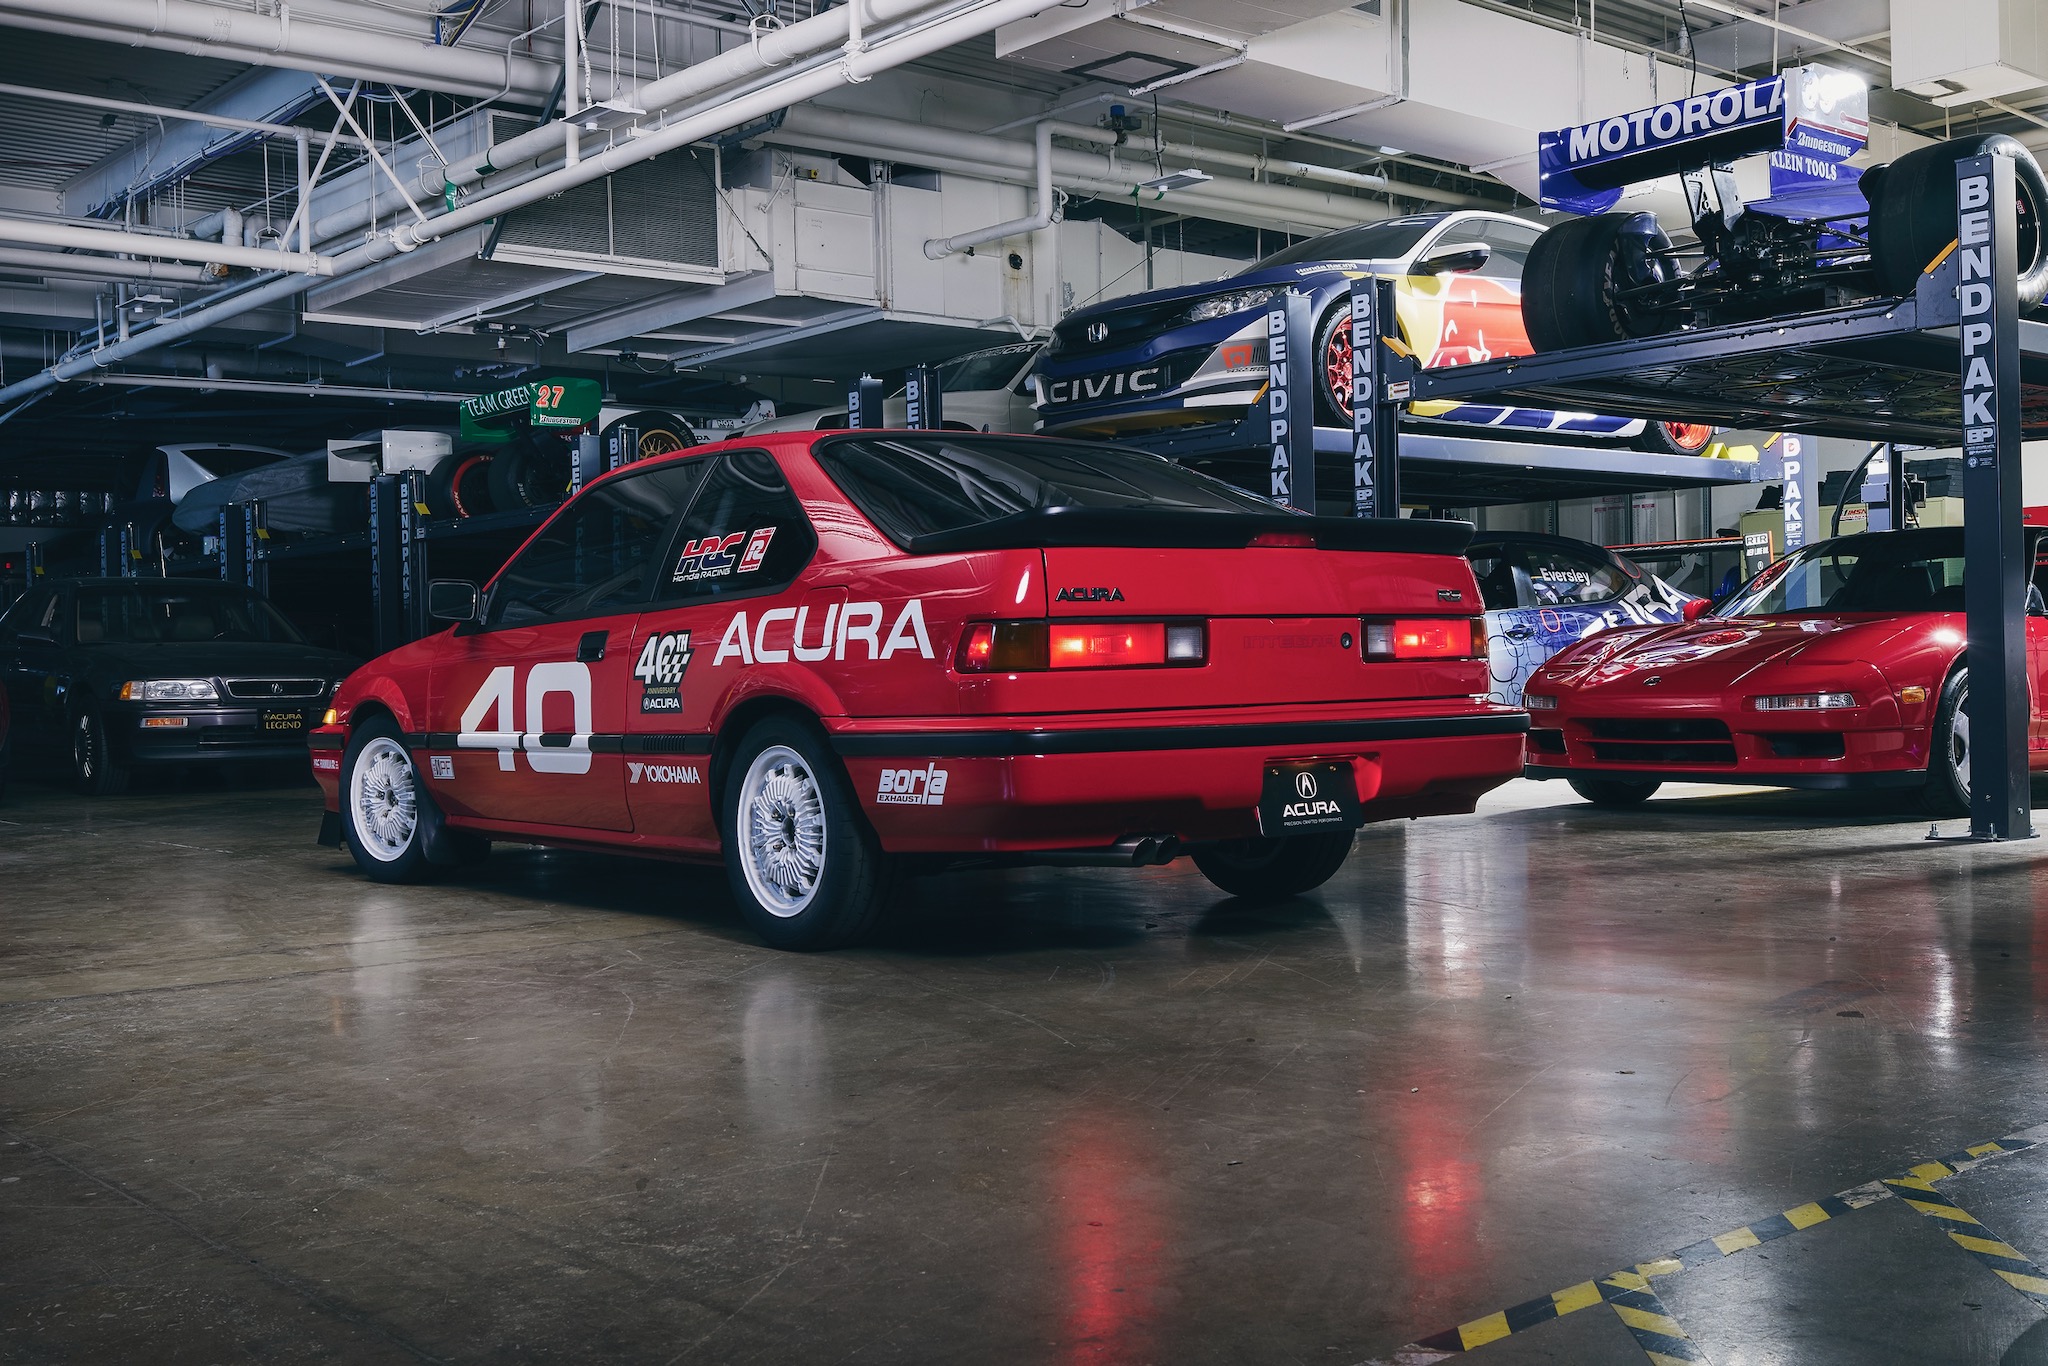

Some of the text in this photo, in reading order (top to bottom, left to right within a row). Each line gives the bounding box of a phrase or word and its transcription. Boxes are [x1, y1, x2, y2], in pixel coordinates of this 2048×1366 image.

[1797, 131, 1852, 158] BRIDGESTONE
[1771, 151, 1838, 181] KLEIN TOOLS
[1959, 175, 1996, 426] BENDPAK
[535, 384, 565, 409] 27
[1050, 367, 1160, 403] CIVIC
[1351, 293, 1375, 487] BENDPAK
[464, 394, 499, 417] TEAM
[1268, 308, 1291, 496] BENDPAK
[1966, 427, 1994, 444] BP
[369, 483, 379, 589] BENDPAK
[401, 483, 410, 591] BENDPAK
[673, 530, 747, 576] HRC
[672, 572, 700, 583] Honda
[699, 567, 731, 579] RACING
[1539, 567, 1592, 586] Eversley
[1055, 587, 1125, 602] ACURA
[712, 599, 936, 667] ACURA
[646, 686, 677, 695] ANNIVERSARY
[649, 698, 680, 709] ACURA
[265, 721, 302, 730] LEGEND
[456, 661, 596, 775] 40
[643, 765, 702, 785] YOKOHAMA
[878, 794, 921, 803] EXHAUST
[1283, 800, 1342, 818] ACURA
